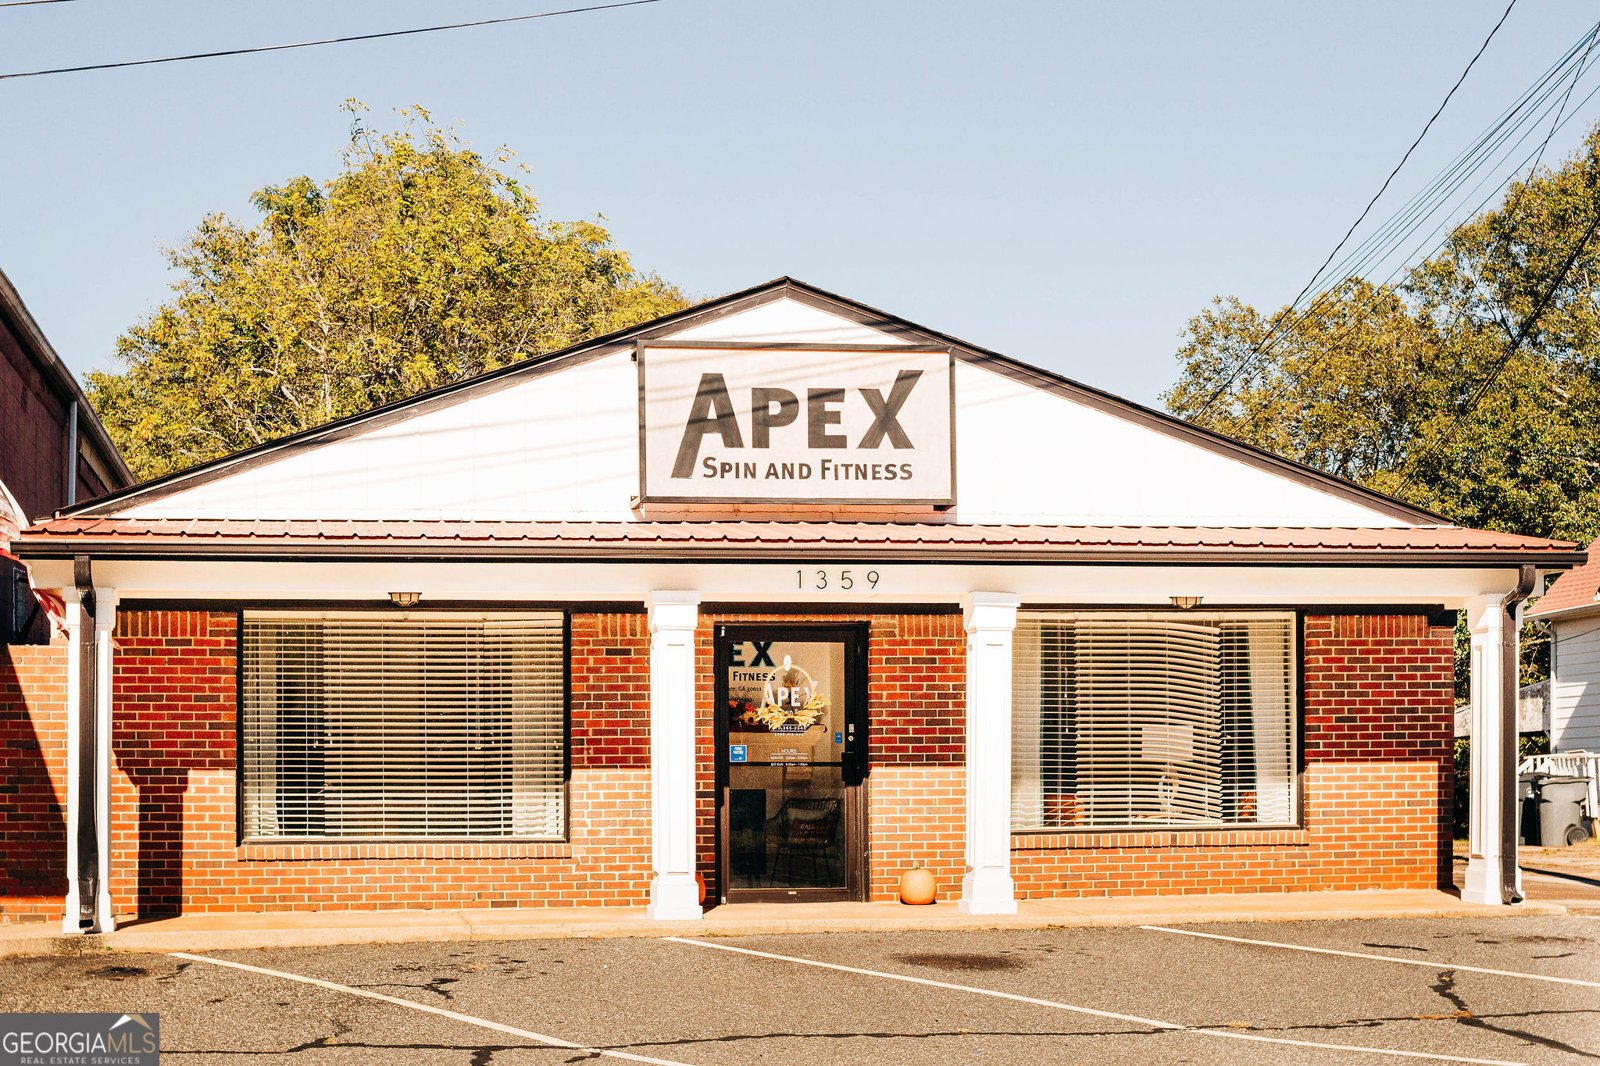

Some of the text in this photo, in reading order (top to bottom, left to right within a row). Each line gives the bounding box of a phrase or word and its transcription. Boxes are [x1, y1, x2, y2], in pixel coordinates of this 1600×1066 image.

[671, 369, 924, 480] APEX
[702, 456, 913, 481] SPIN AND FITNESS
[796, 570, 880, 590] 1359
